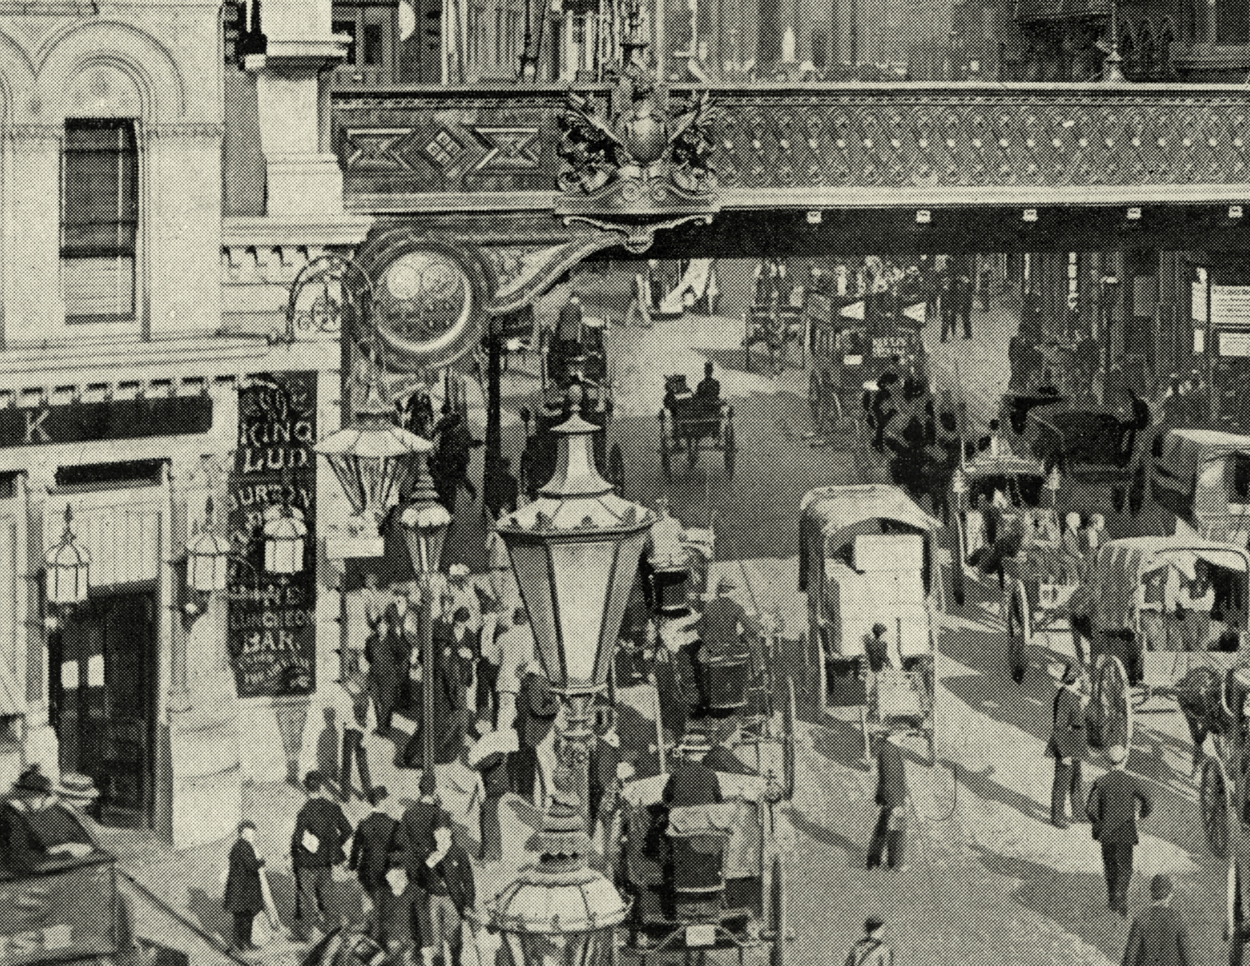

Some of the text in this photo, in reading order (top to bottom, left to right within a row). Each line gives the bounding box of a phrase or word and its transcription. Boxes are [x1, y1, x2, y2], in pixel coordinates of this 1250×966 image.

[23, 410, 52, 444] K
[240, 420, 316, 447] KING
[242, 447, 310, 474] LUD
[230, 609, 316, 630] LUNCHEON
